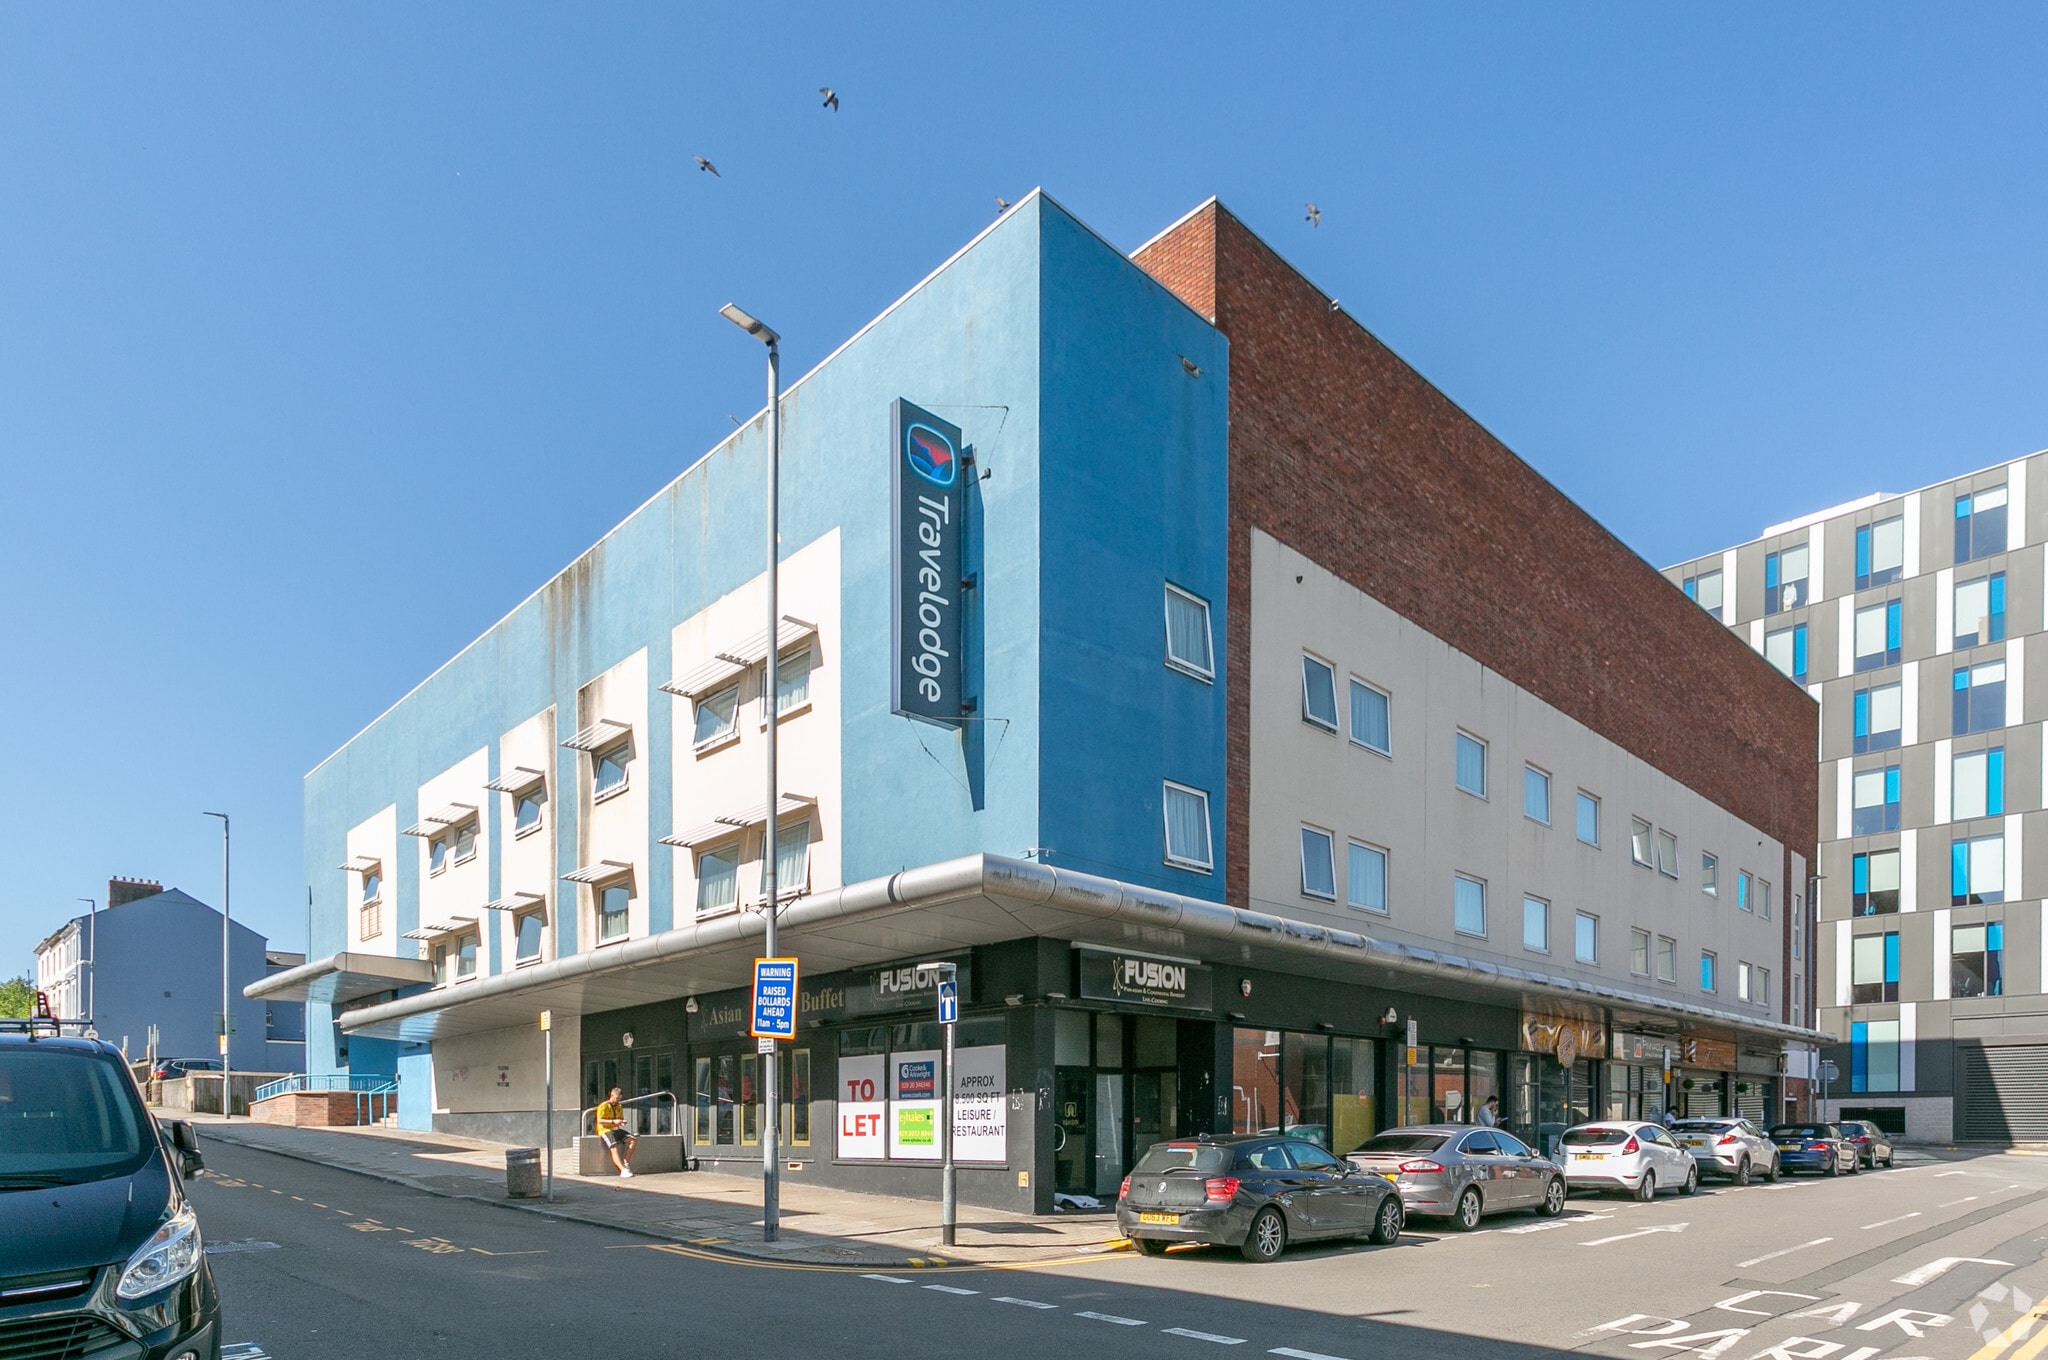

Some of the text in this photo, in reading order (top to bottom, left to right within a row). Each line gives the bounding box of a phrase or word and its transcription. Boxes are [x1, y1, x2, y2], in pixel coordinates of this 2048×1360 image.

[912, 495, 949, 702] Travelodge
[760, 967, 791, 977] WARNING
[1125, 960, 1185, 990] FUSION
[880, 967, 940, 993] FUSION
[763, 986, 786, 996] RAISED
[709, 987, 844, 1026] Asian Buffet
[758, 997, 791, 1007] BOLLARDS
[762, 1006, 785, 1017] AHEAD
[757, 1018, 771, 1028] 11am
[776, 1018, 790, 1030] 5pm
[961, 1075, 994, 1087] APPROX
[847, 1079, 875, 1102] TO
[977, 1092, 988, 1103] SQ
[991, 1092, 1000, 1103] FT
[957, 1109, 991, 1120] LEISURE
[843, 1114, 880, 1136] LET
[953, 1125, 1005, 1136] RESTAURANT
[1714, 1290, 1955, 1337] CAR
